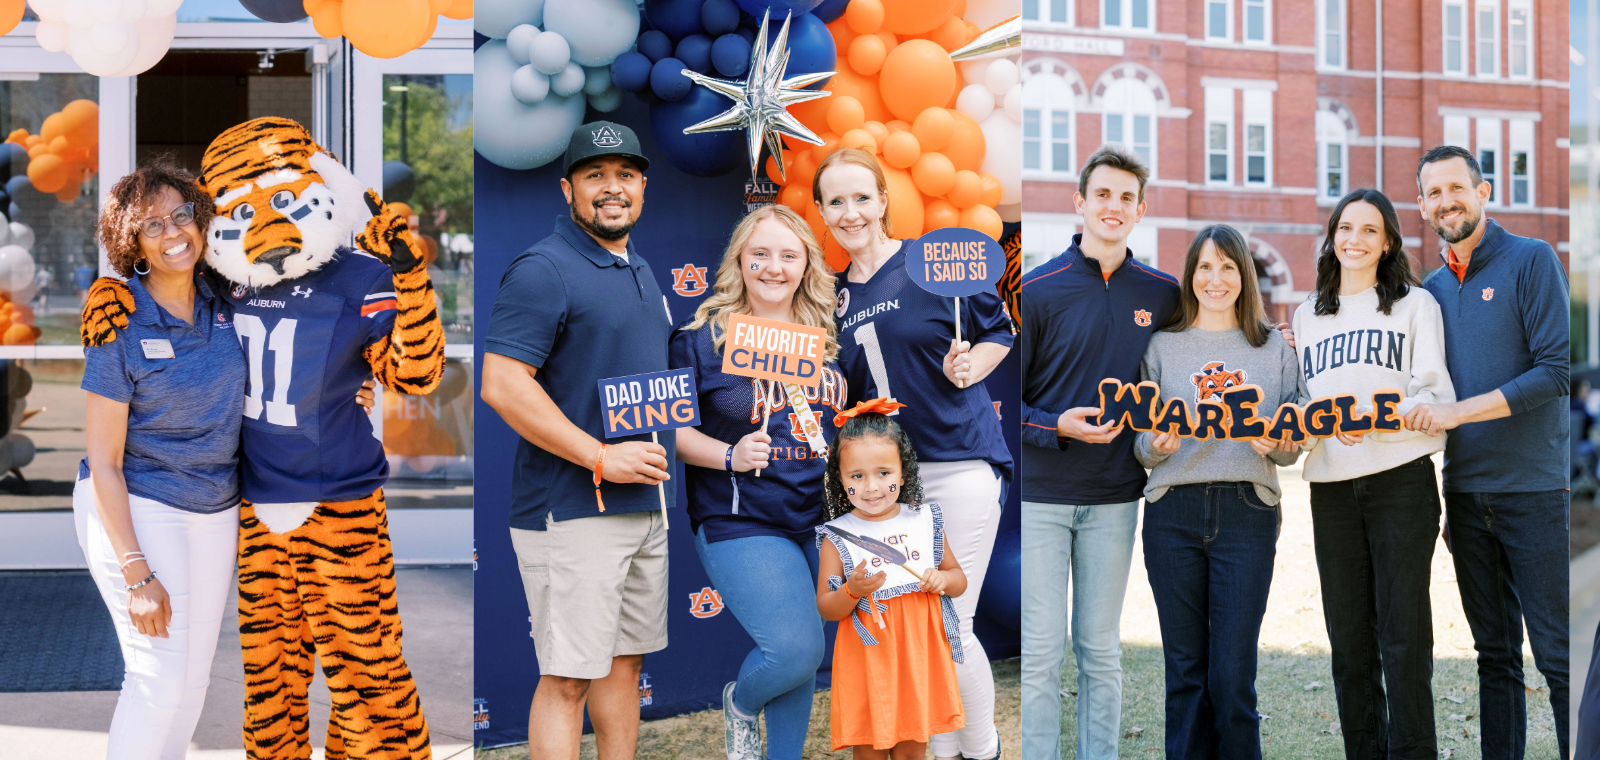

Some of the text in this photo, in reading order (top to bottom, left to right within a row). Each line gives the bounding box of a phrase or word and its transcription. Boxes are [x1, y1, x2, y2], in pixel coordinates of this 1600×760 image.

[745, 184, 778, 194] FALL
[923, 241, 987, 262] BECAUSE
[925, 261, 987, 282] I SAID SO
[246, 299, 285, 308] AUBURN
[841, 299, 901, 332] AUBURN
[734, 322, 819, 358] FAVORITE
[1303, 329, 1406, 383] AUBURN
[731, 348, 816, 379] CHILD
[605, 374, 692, 408] DAD JOKE
[608, 398, 695, 433] KING
